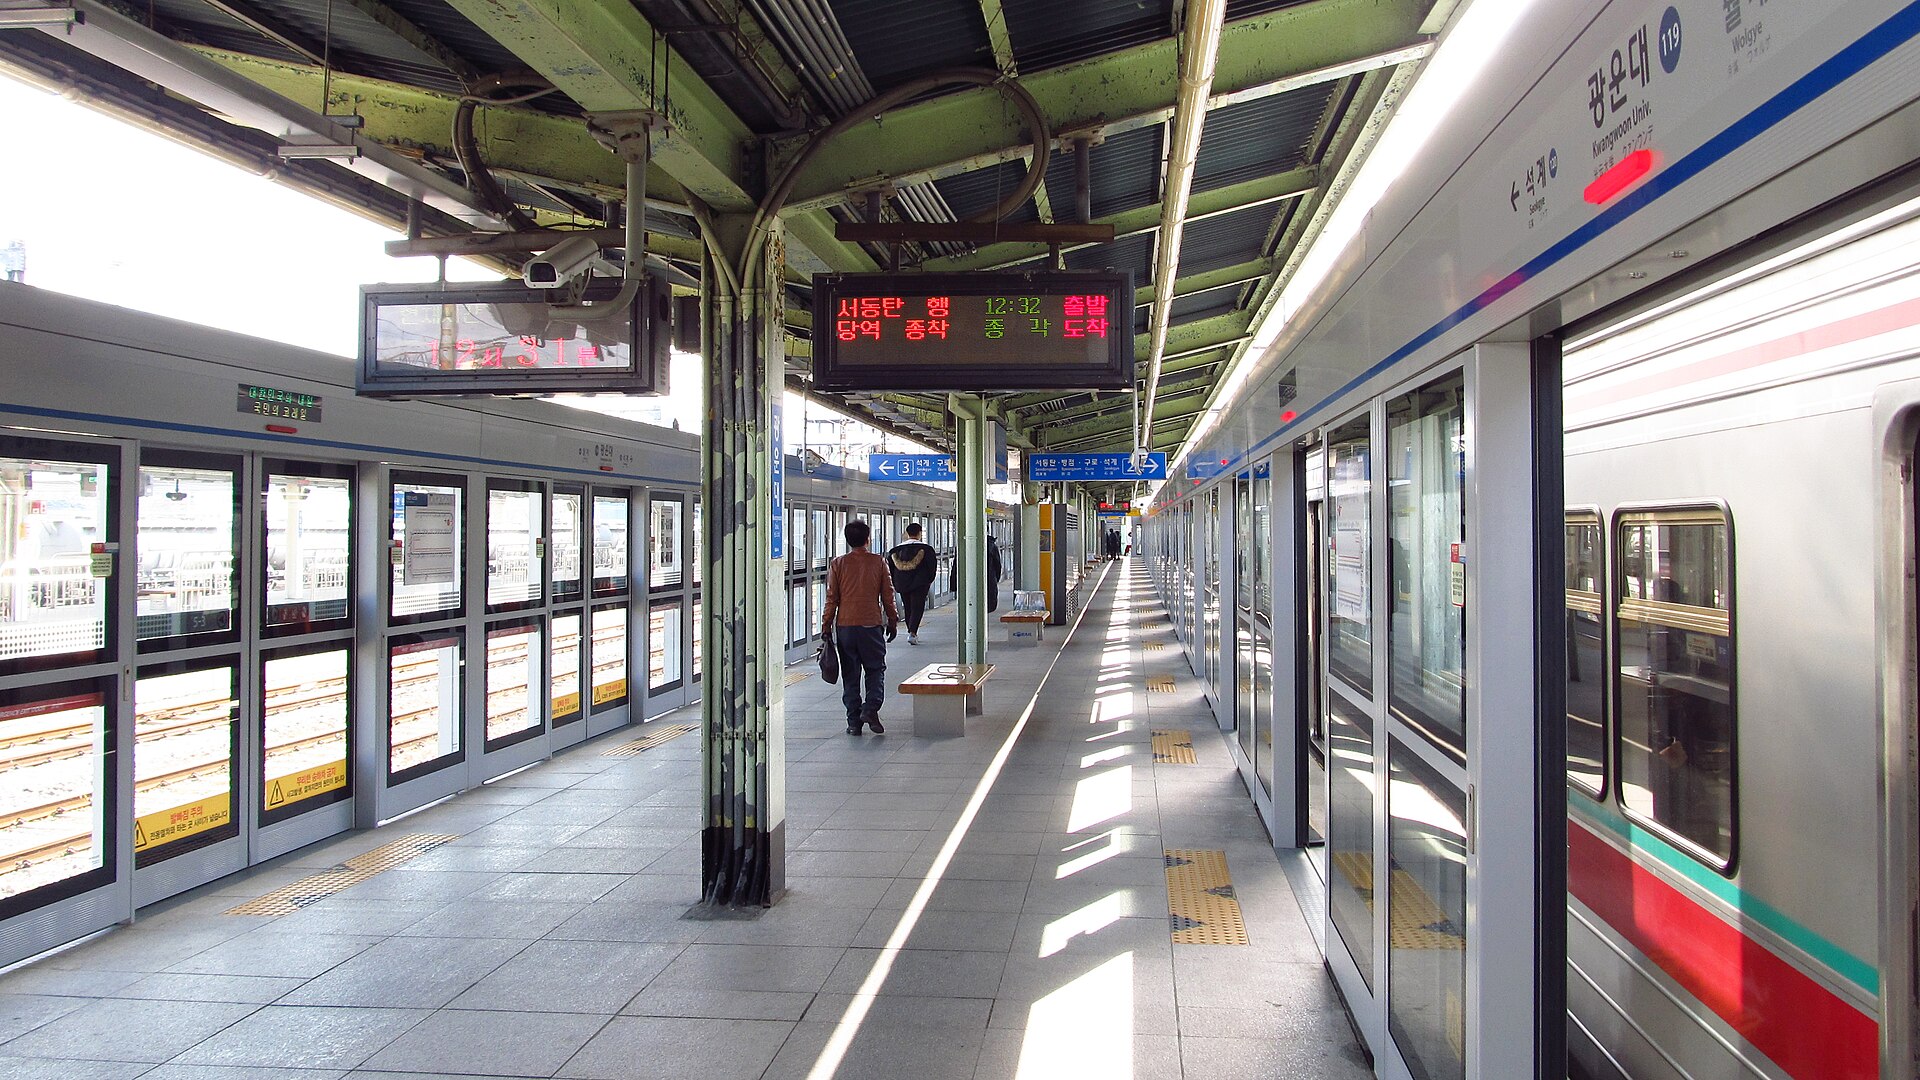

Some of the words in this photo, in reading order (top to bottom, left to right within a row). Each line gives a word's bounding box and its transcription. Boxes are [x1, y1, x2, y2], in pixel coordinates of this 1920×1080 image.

[1661, 22, 1681, 57] 119
[1732, 21, 1763, 54] Wolgye
[1587, 23, 1650, 129] 광운대
[1592, 117, 1632, 159] Kwangwoon
[1632, 99, 1652, 126] Univ.
[837, 297, 904, 319] 서동탄
[927, 296, 949, 318] 행
[985, 297, 1041, 315] 12:32
[1064, 295, 1110, 317] 출발
[837, 319, 881, 341] 당역
[905, 318, 950, 340] 종착
[1063, 318, 1110, 339] 도착
[254, 401, 279, 416] 국민의
[282, 406, 307, 421] 코레일
[901, 461, 910, 474] 3
[193, 615, 206, 628] 5-3
[190, 805, 203, 818] 주의
